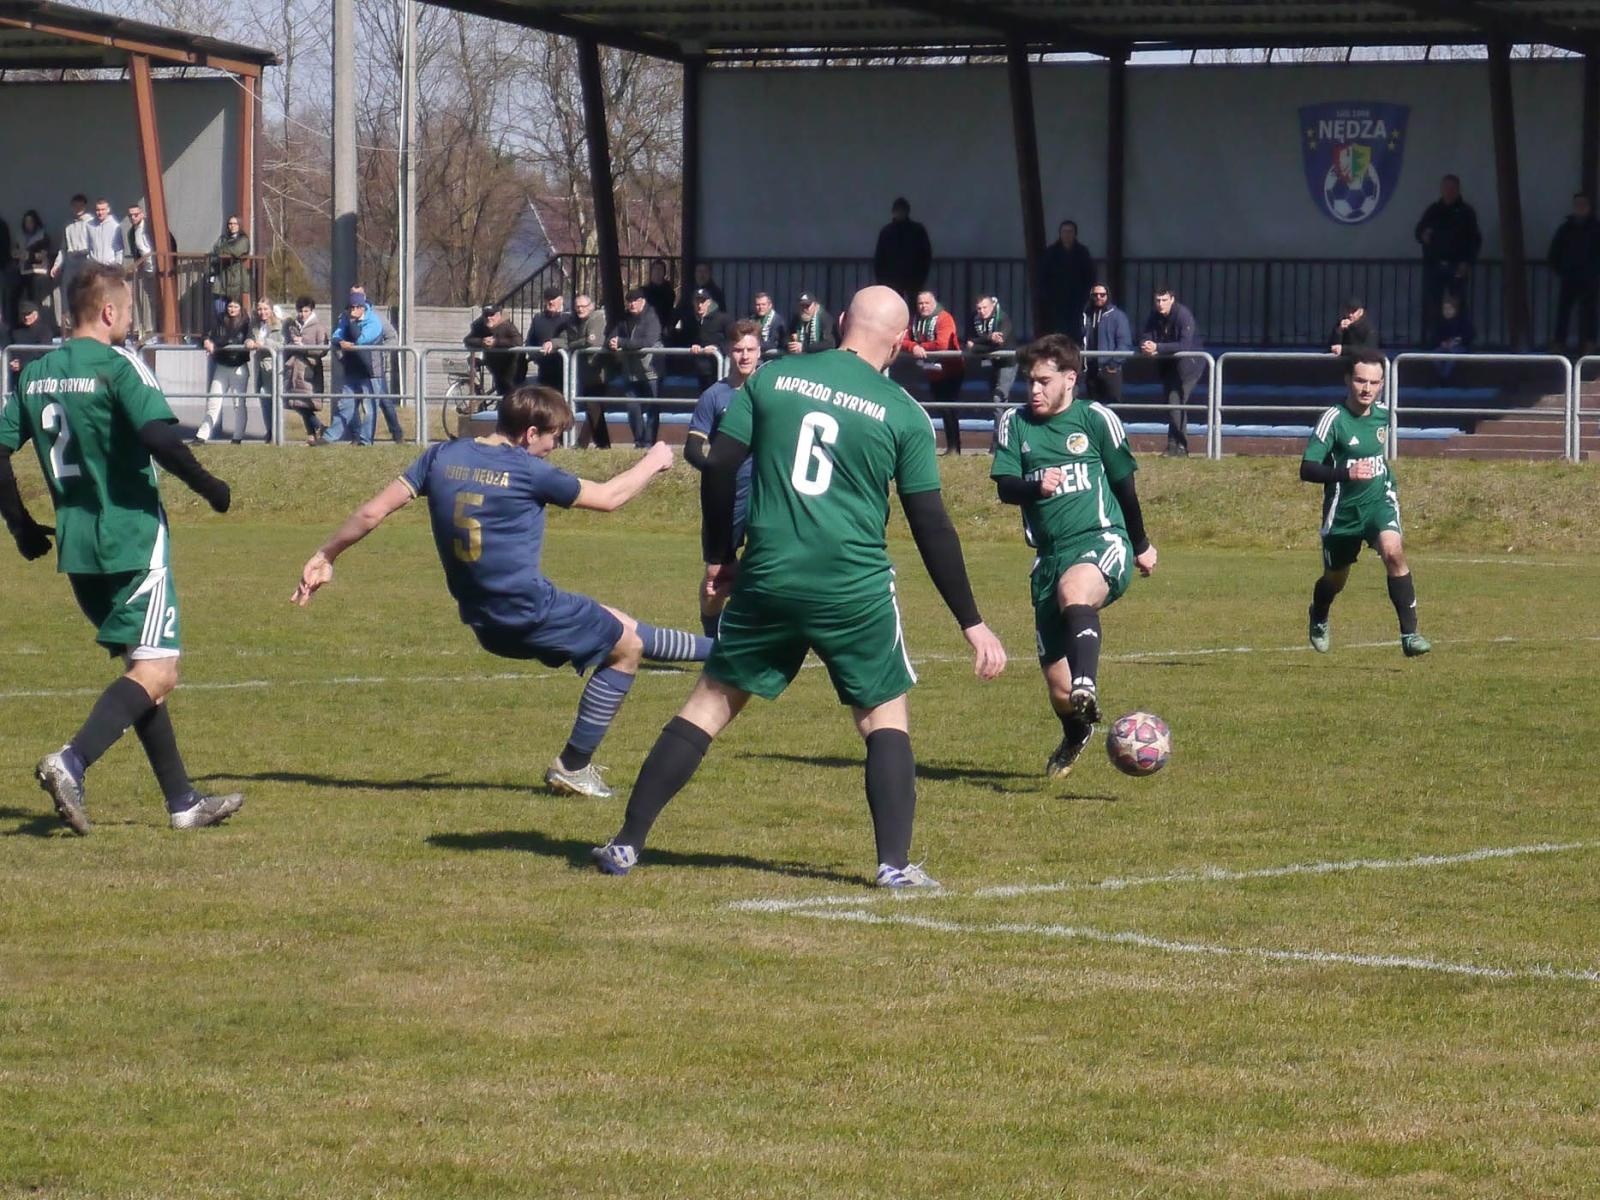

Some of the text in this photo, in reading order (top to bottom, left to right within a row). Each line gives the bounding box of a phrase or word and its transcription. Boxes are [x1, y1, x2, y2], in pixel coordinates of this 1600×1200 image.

[1319, 119, 1387, 143] NĘDZA
[774, 376, 886, 422] NAPRZÓD SYRYNIA
[41, 402, 81, 479] 2
[791, 411, 839, 496] 6
[453, 491, 485, 562] 5
[163, 606, 176, 638] 2
